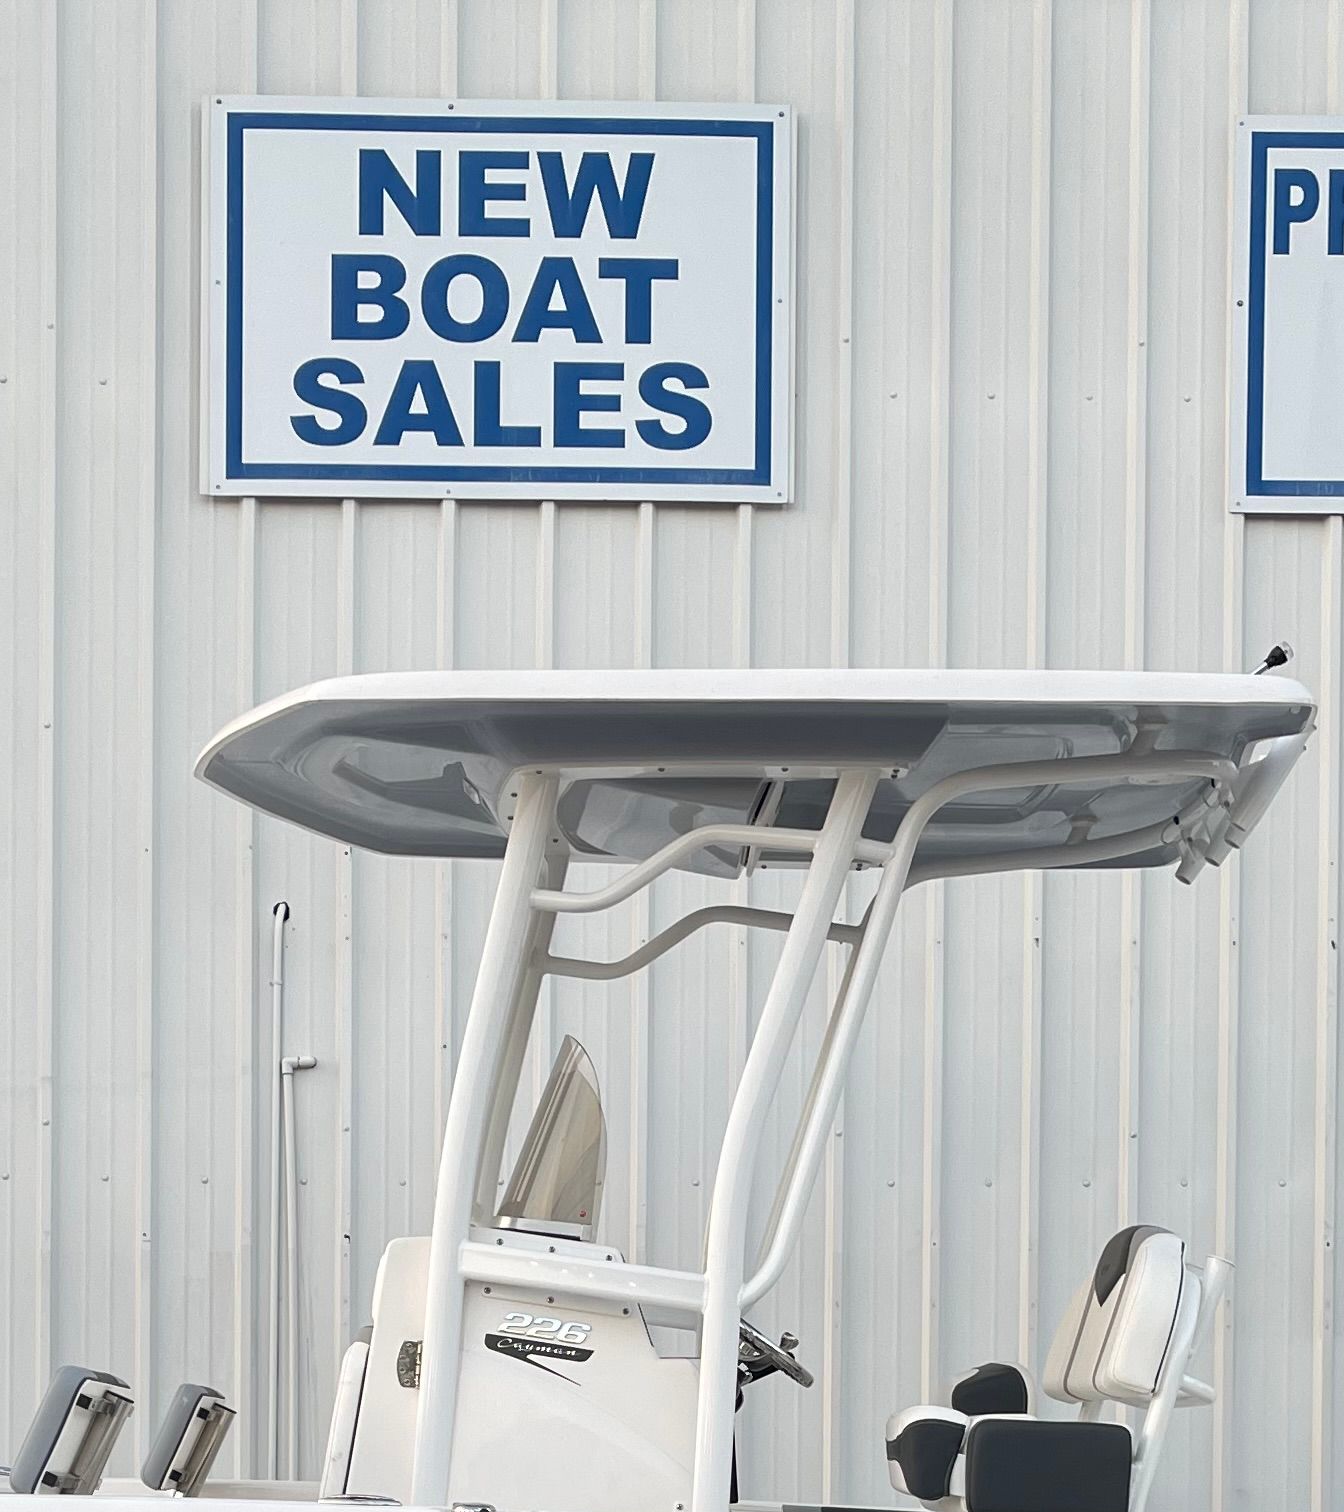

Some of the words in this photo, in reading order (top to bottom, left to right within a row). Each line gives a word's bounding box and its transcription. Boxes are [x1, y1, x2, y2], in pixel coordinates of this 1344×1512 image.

[358, 148, 656, 239] NEW
[330, 253, 679, 345] BOAT
[289, 357, 713, 451] SALES
[497, 1312, 592, 1344] 226
